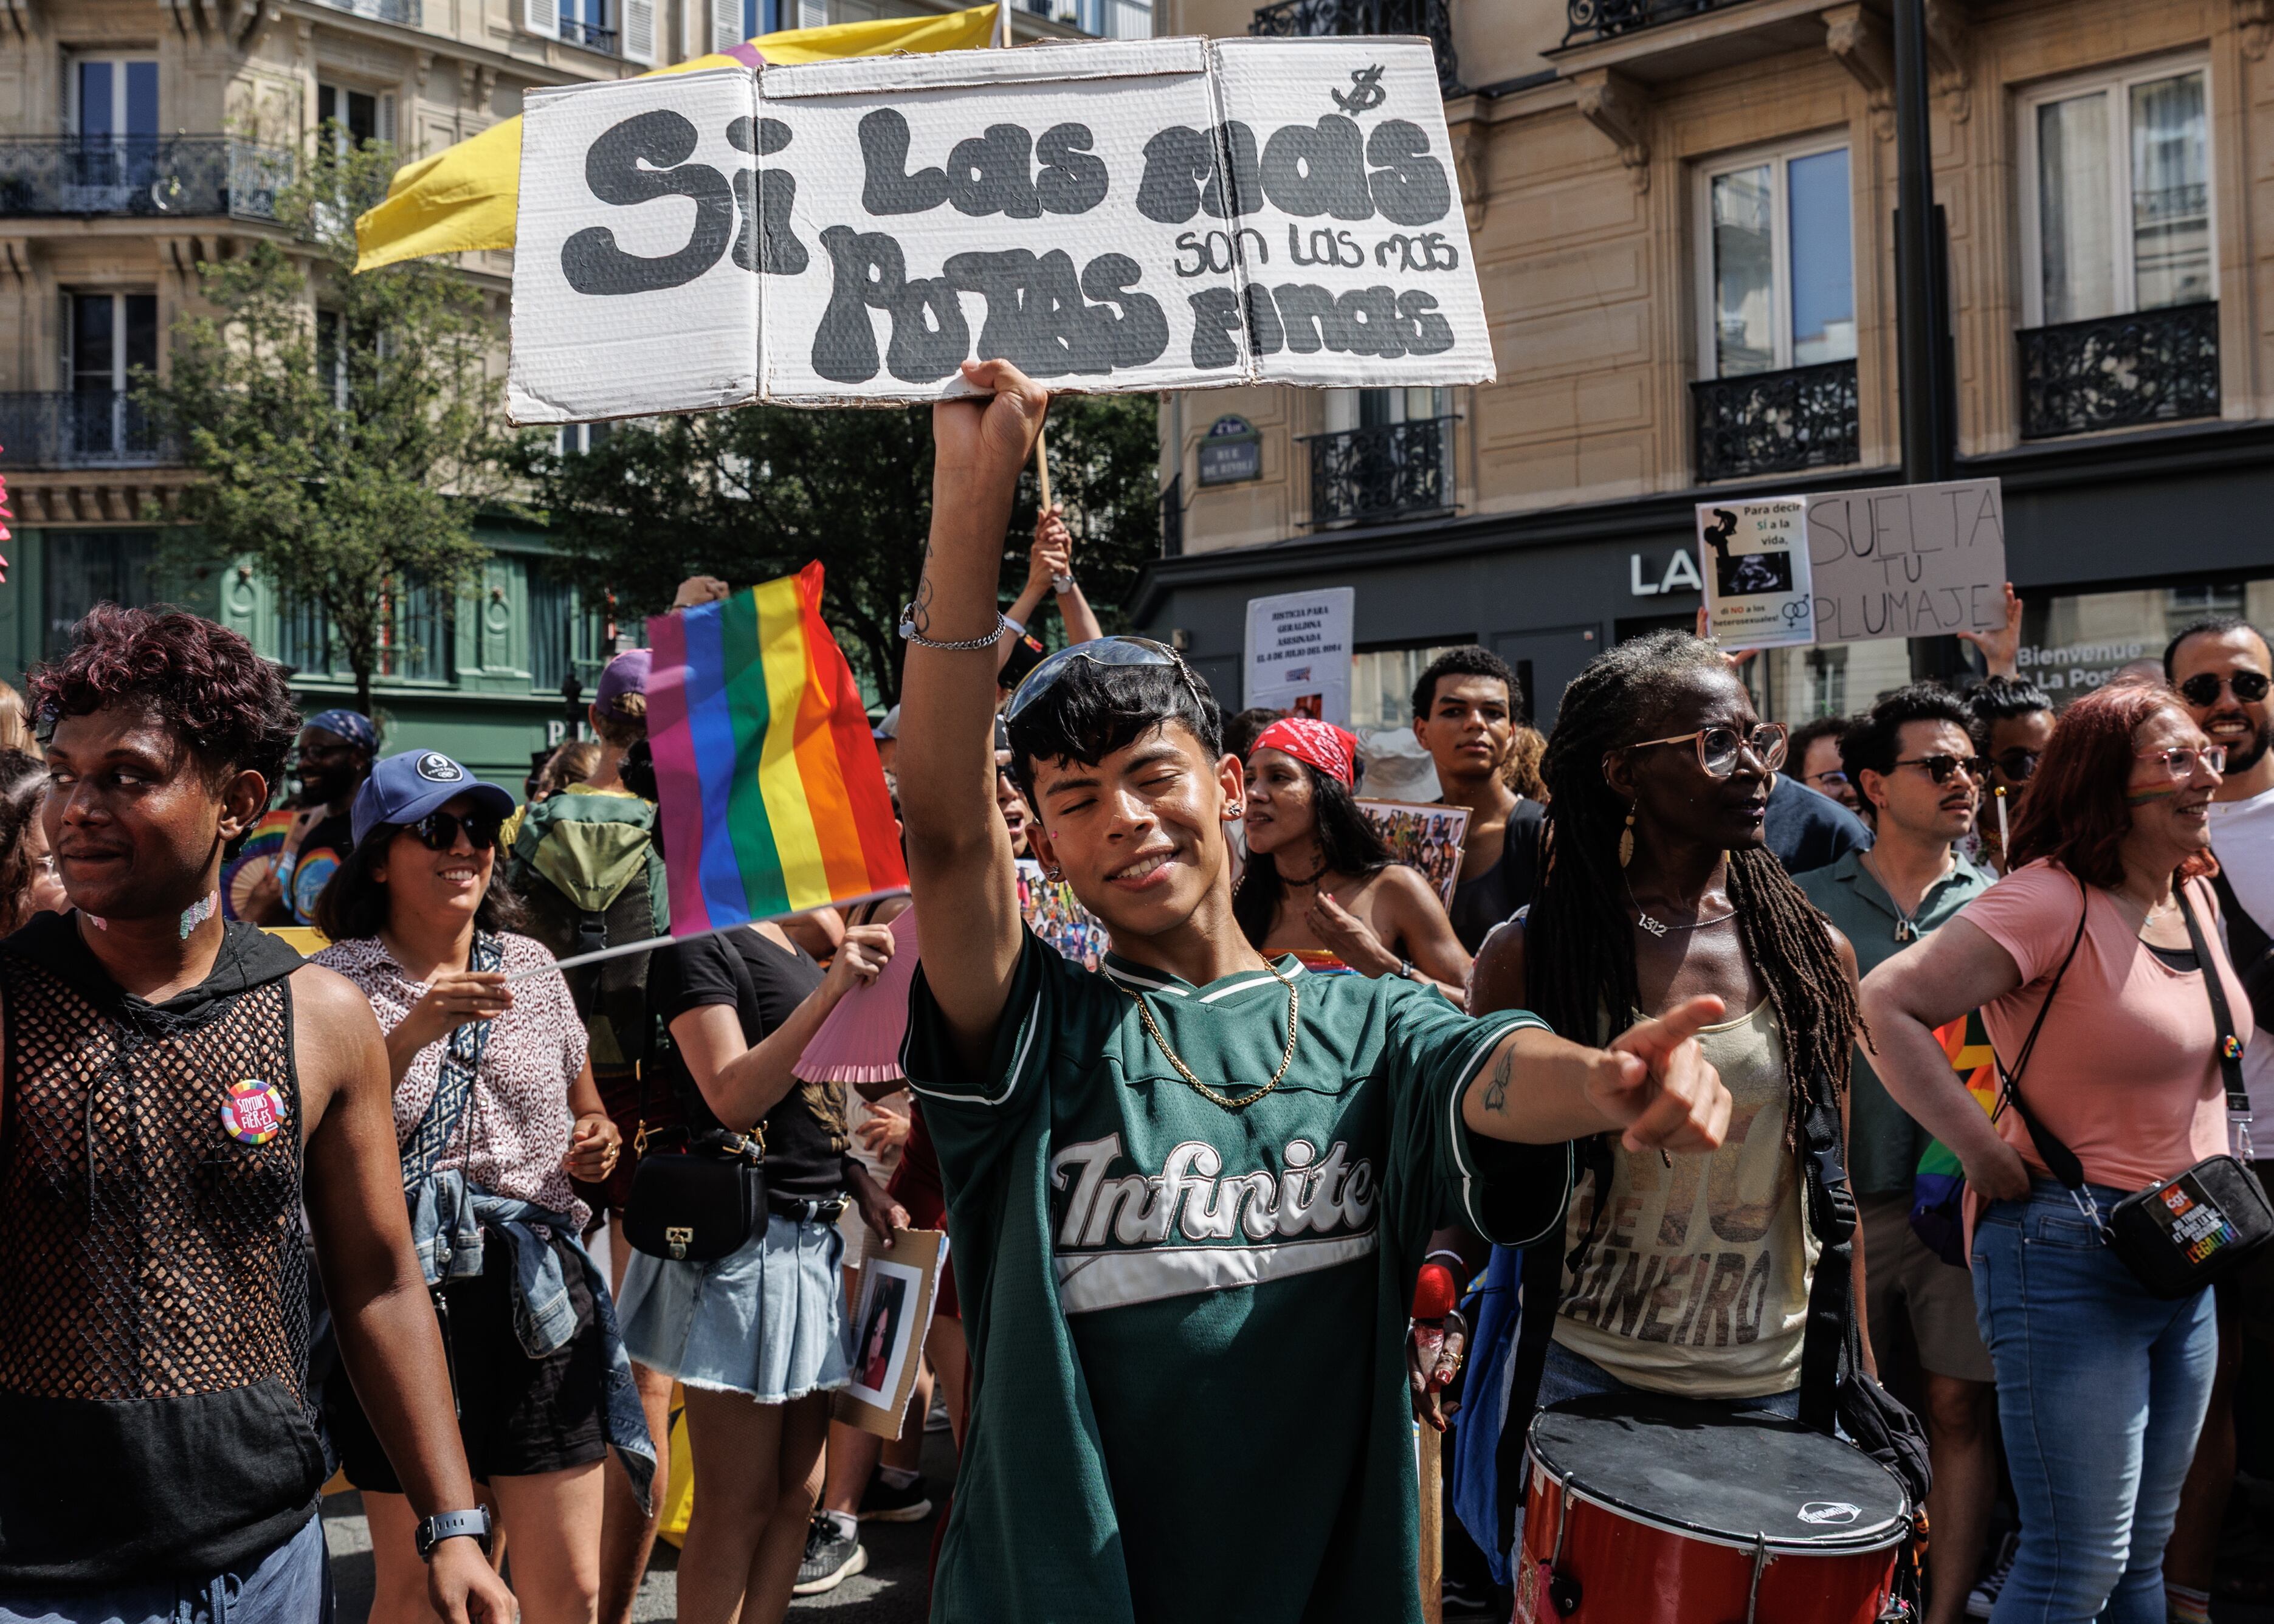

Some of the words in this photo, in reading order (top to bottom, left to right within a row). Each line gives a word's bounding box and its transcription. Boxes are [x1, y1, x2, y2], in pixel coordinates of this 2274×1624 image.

[561, 109, 809, 295] Si
[858, 108, 1109, 218] Las
[1174, 229, 1268, 277] son
[1744, 506, 1769, 516] Para
[1773, 503, 1800, 514] decir
[1779, 518, 1790, 529] la
[1807, 488, 2005, 566] SUELTA
[1631, 548, 1702, 596] LA
[1872, 554, 1922, 585] TU
[1814, 584, 1993, 645] PLUMAJE
[2017, 644, 2143, 667] Bienvenue
[2037, 670, 2065, 690] La
[236, 1093, 268, 1113] SOYONS
[1050, 1132, 1378, 1247] Infinite
[2166, 1189, 2189, 1209] cgt
